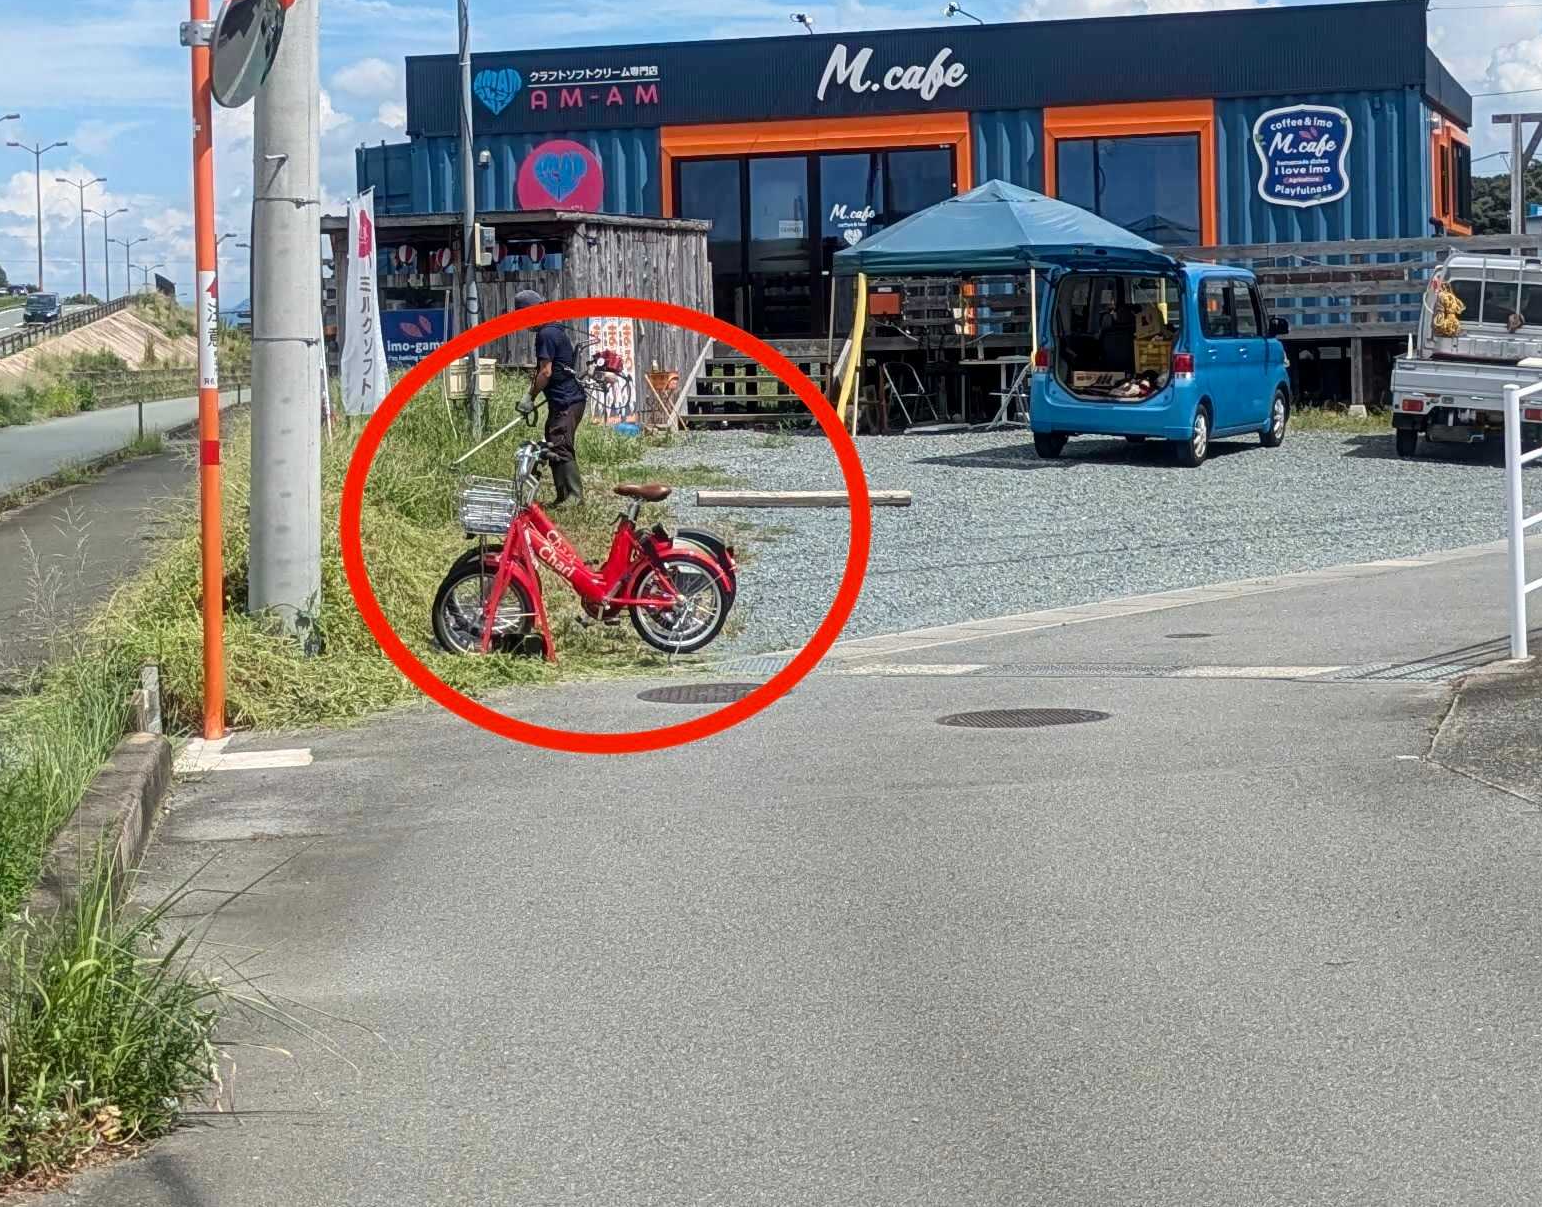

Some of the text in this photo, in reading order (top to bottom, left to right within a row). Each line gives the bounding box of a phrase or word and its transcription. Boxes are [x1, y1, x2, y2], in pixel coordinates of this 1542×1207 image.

[529, 66, 658, 82] クラフトソフトクリーム専門店
[1270, 118, 1302, 130] coffee
[1304, 117, 1312, 126] &
[1268, 132, 1337, 156] M.cafe
[1281, 166, 1307, 175] love
[1275, 184, 1333, 196] Playfulness
[387, 340, 444, 354] imo-gam
